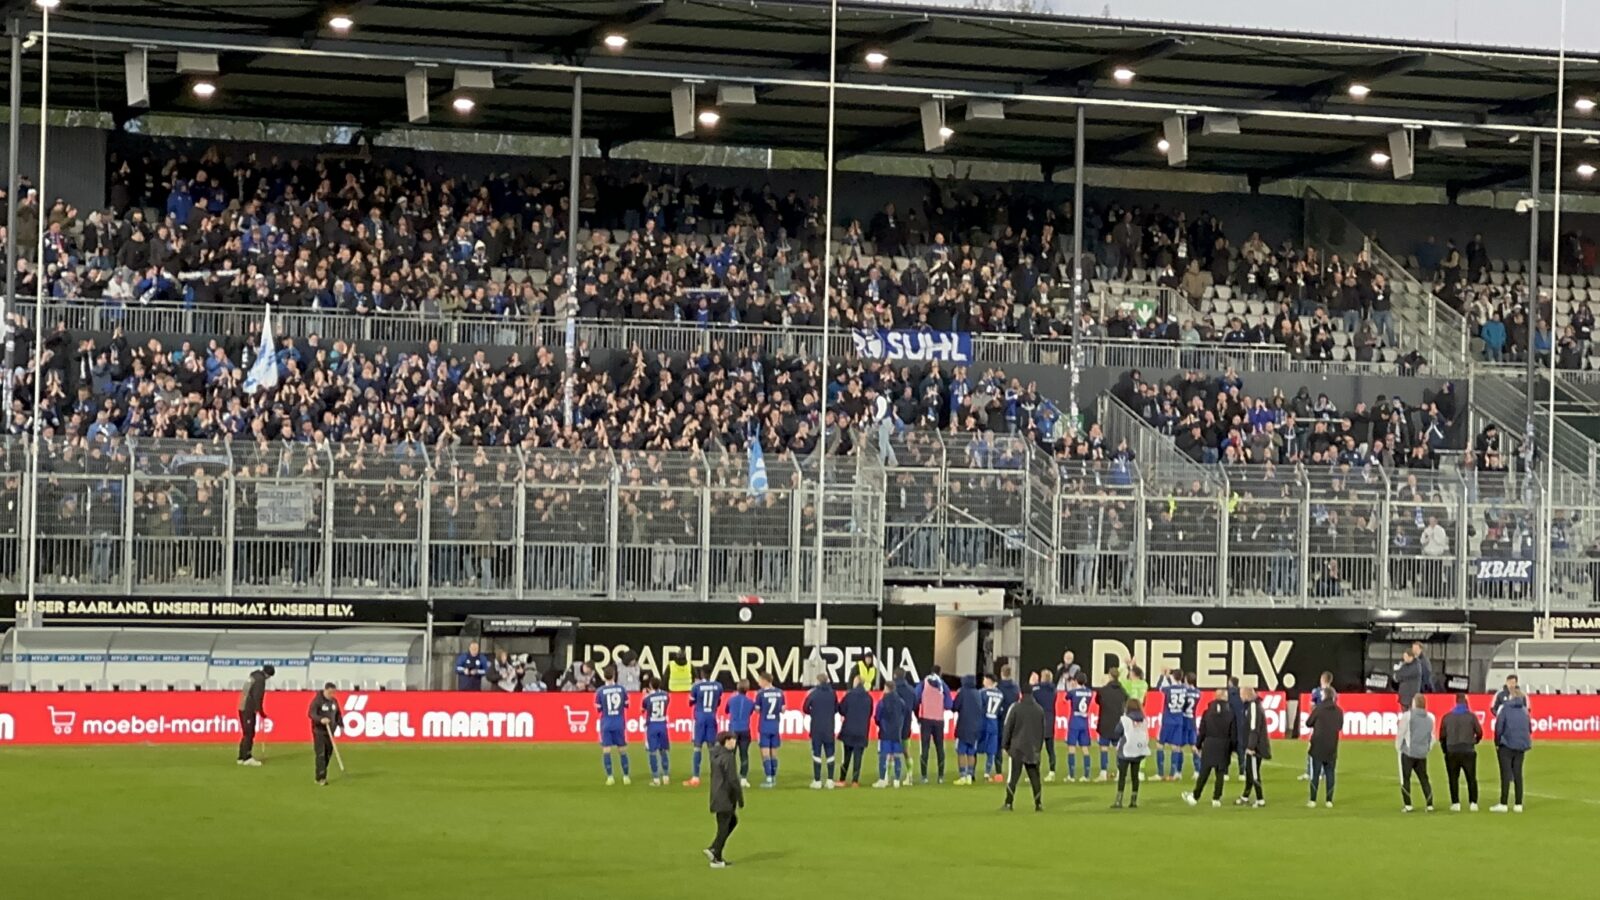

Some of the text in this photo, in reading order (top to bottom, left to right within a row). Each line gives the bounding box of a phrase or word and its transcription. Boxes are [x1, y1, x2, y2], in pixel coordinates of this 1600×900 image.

[887, 331, 968, 361] SUHL
[1477, 561, 1532, 578] KBAK
[67, 600, 150, 614] SAARLAND.
[152, 601, 209, 615] UNSERE
[211, 602, 268, 616] HEIMAT.
[269, 603, 325, 616] UNSERE
[327, 604, 355, 617] ELV.
[1092, 639, 1296, 690] DIE ELV.
[606, 692, 621, 709] 19
[987, 697, 1001, 713] 17
[1078, 697, 1088, 713] 6
[1168, 694, 1185, 709] 35
[334, 694, 534, 738] ÖBEL MARTIN
[651, 701, 665, 718] 51
[83, 715, 273, 734] moebel-martine
